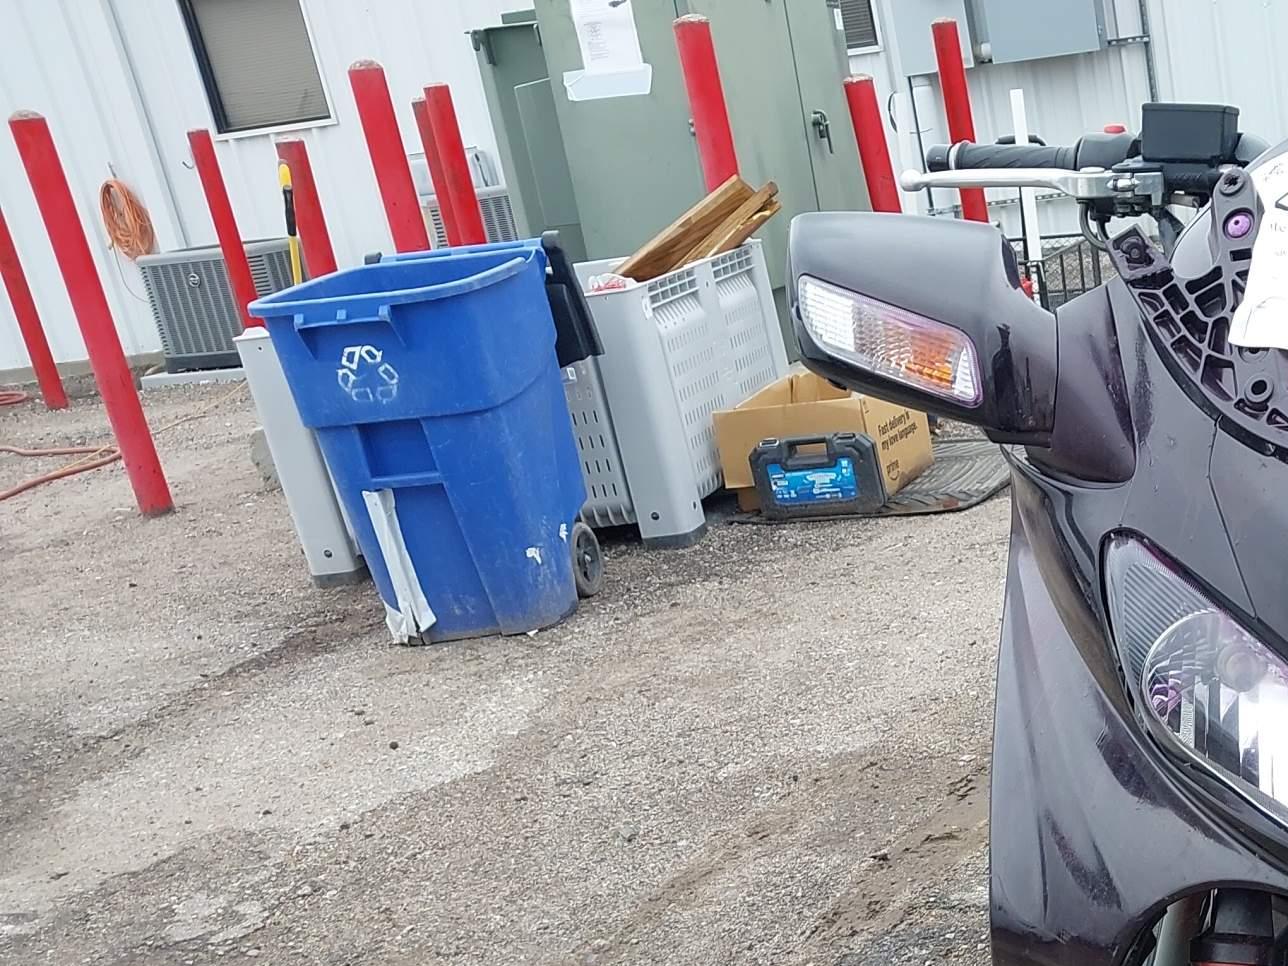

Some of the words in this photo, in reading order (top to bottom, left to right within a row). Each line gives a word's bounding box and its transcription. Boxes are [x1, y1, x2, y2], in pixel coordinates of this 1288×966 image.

[878, 423, 890, 437] Fast
[889, 414, 906, 430] delivery
[881, 440, 889, 451] my
[889, 433, 899, 446] love
